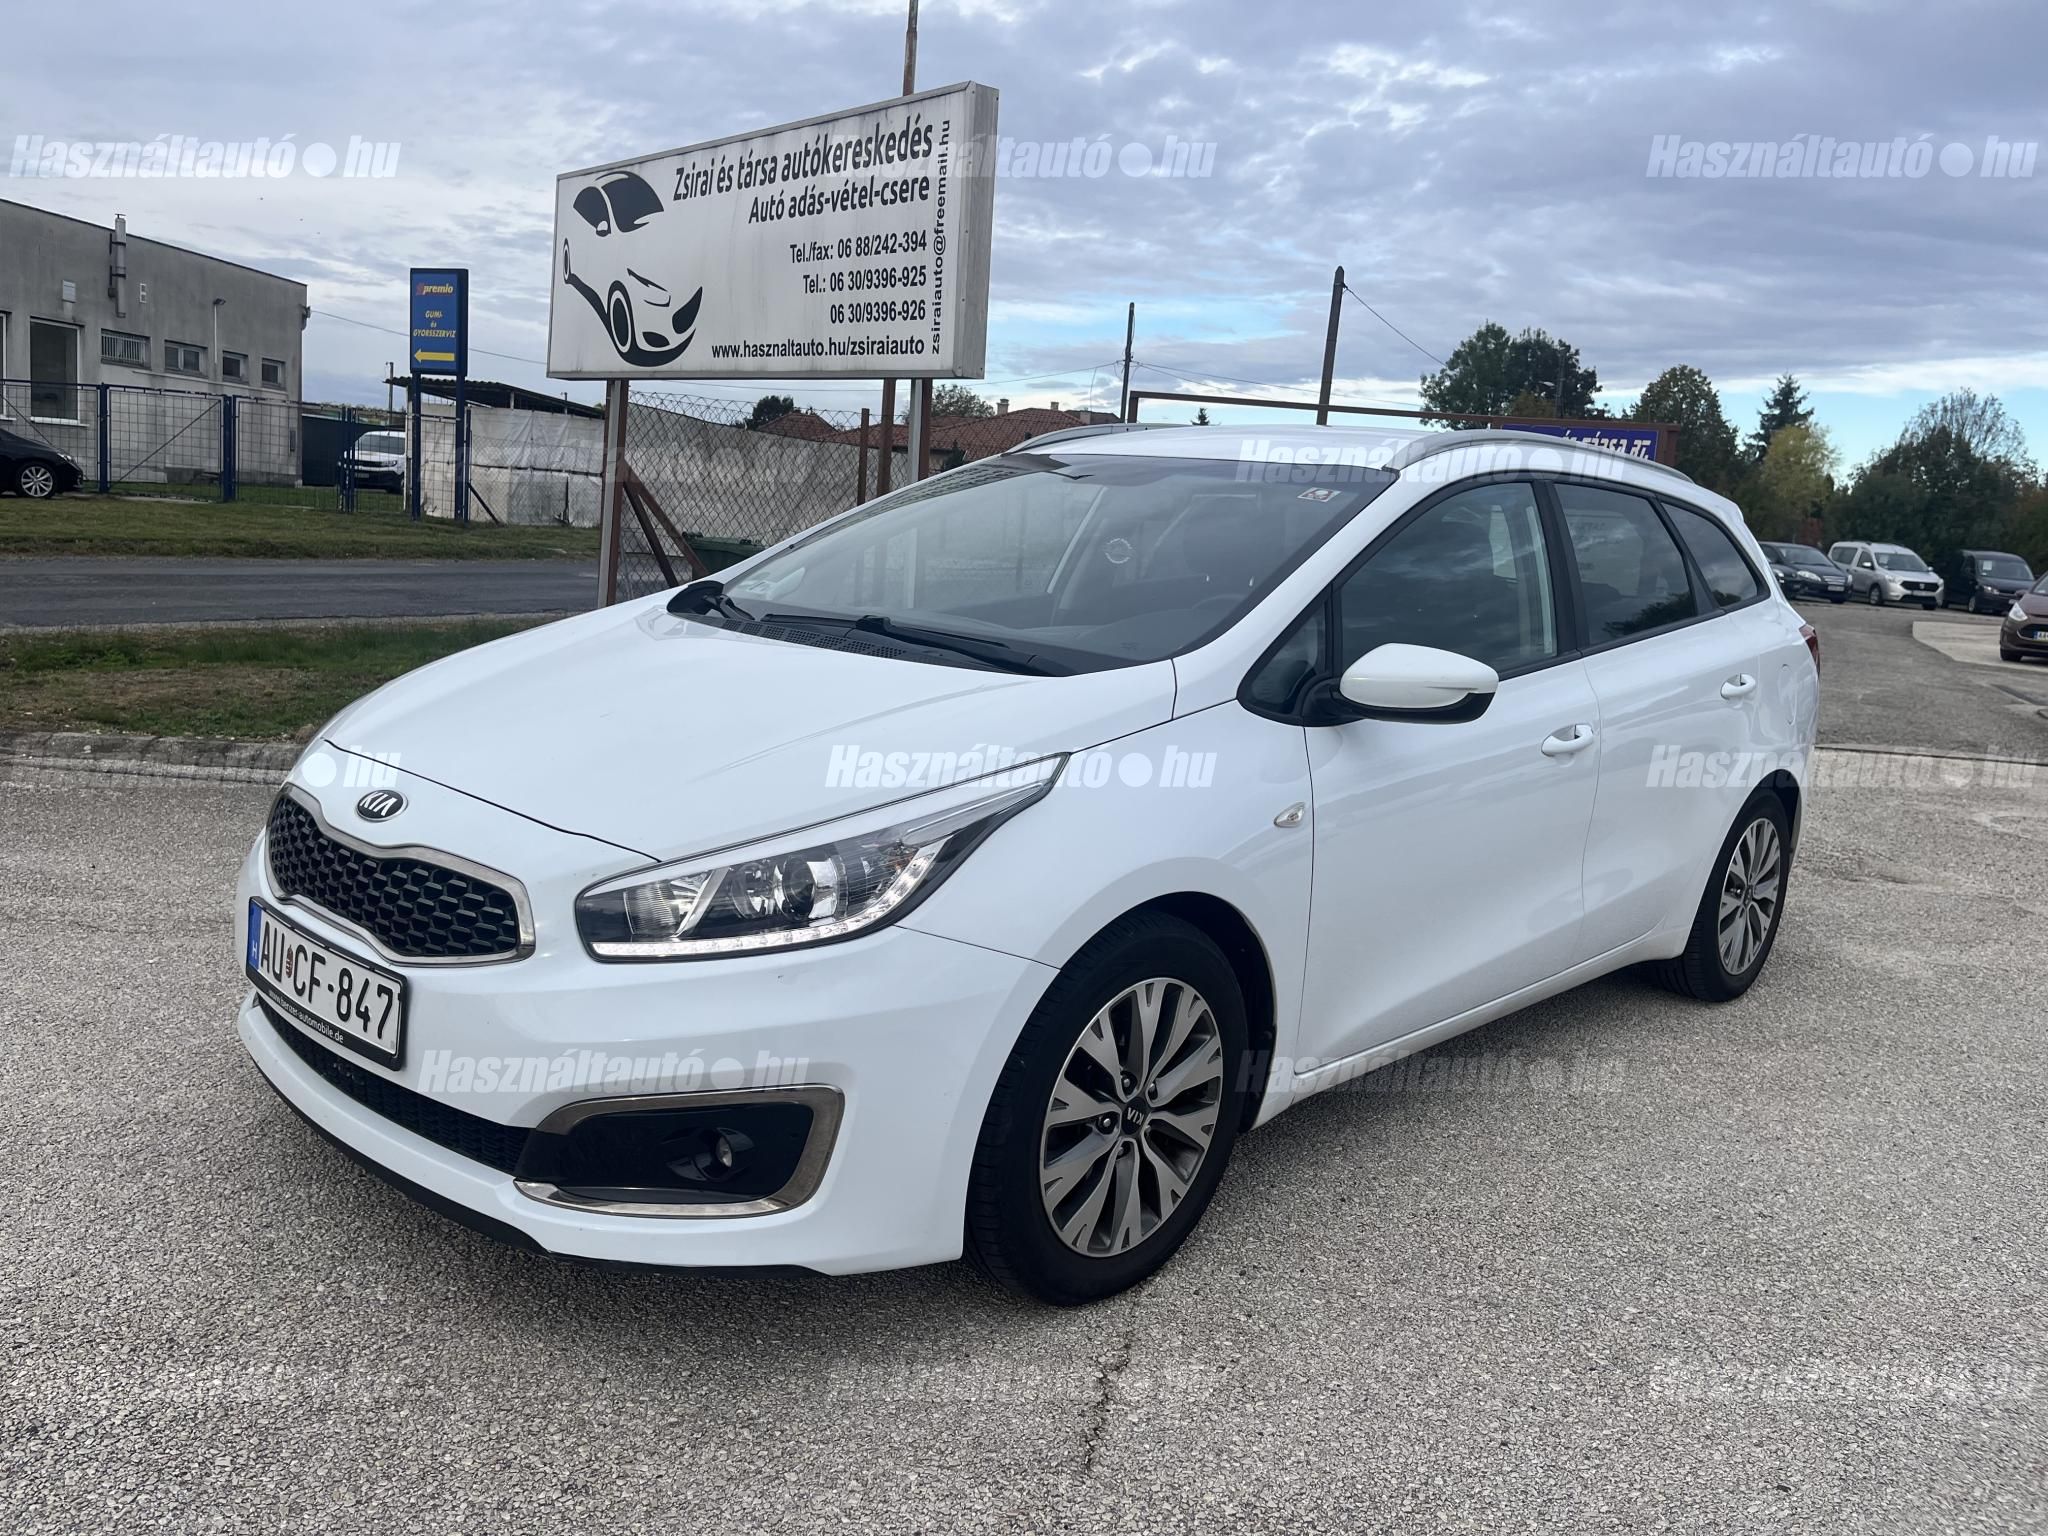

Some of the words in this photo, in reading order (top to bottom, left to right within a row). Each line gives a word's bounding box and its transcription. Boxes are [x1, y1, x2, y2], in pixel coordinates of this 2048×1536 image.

[673, 161, 715, 201] Zsirai
[717, 154, 734, 194] és
[737, 147, 778, 190] társa
[781, 113, 933, 182] autókereskedés
[748, 189, 785, 224] Autó
[788, 175, 930, 219] adás-vétel-csere
[790, 241, 833, 263] Tel./fax:
[837, 238, 852, 258] 06
[855, 230, 927, 257] 88/242-394
[931, 120, 950, 355] zsiraiauto@freemail.hu
[423, 283, 454, 295] premio
[803, 273, 826, 294] Tel.:
[830, 272, 844, 292] 06
[848, 265, 926, 291] 30/9396-925
[830, 304, 844, 324] 06
[848, 299, 926, 323] 30/9396-926
[711, 335, 925, 358] www.hasznaltauto.hu/zsiraiauto
[360, 792, 398, 816] KIA
